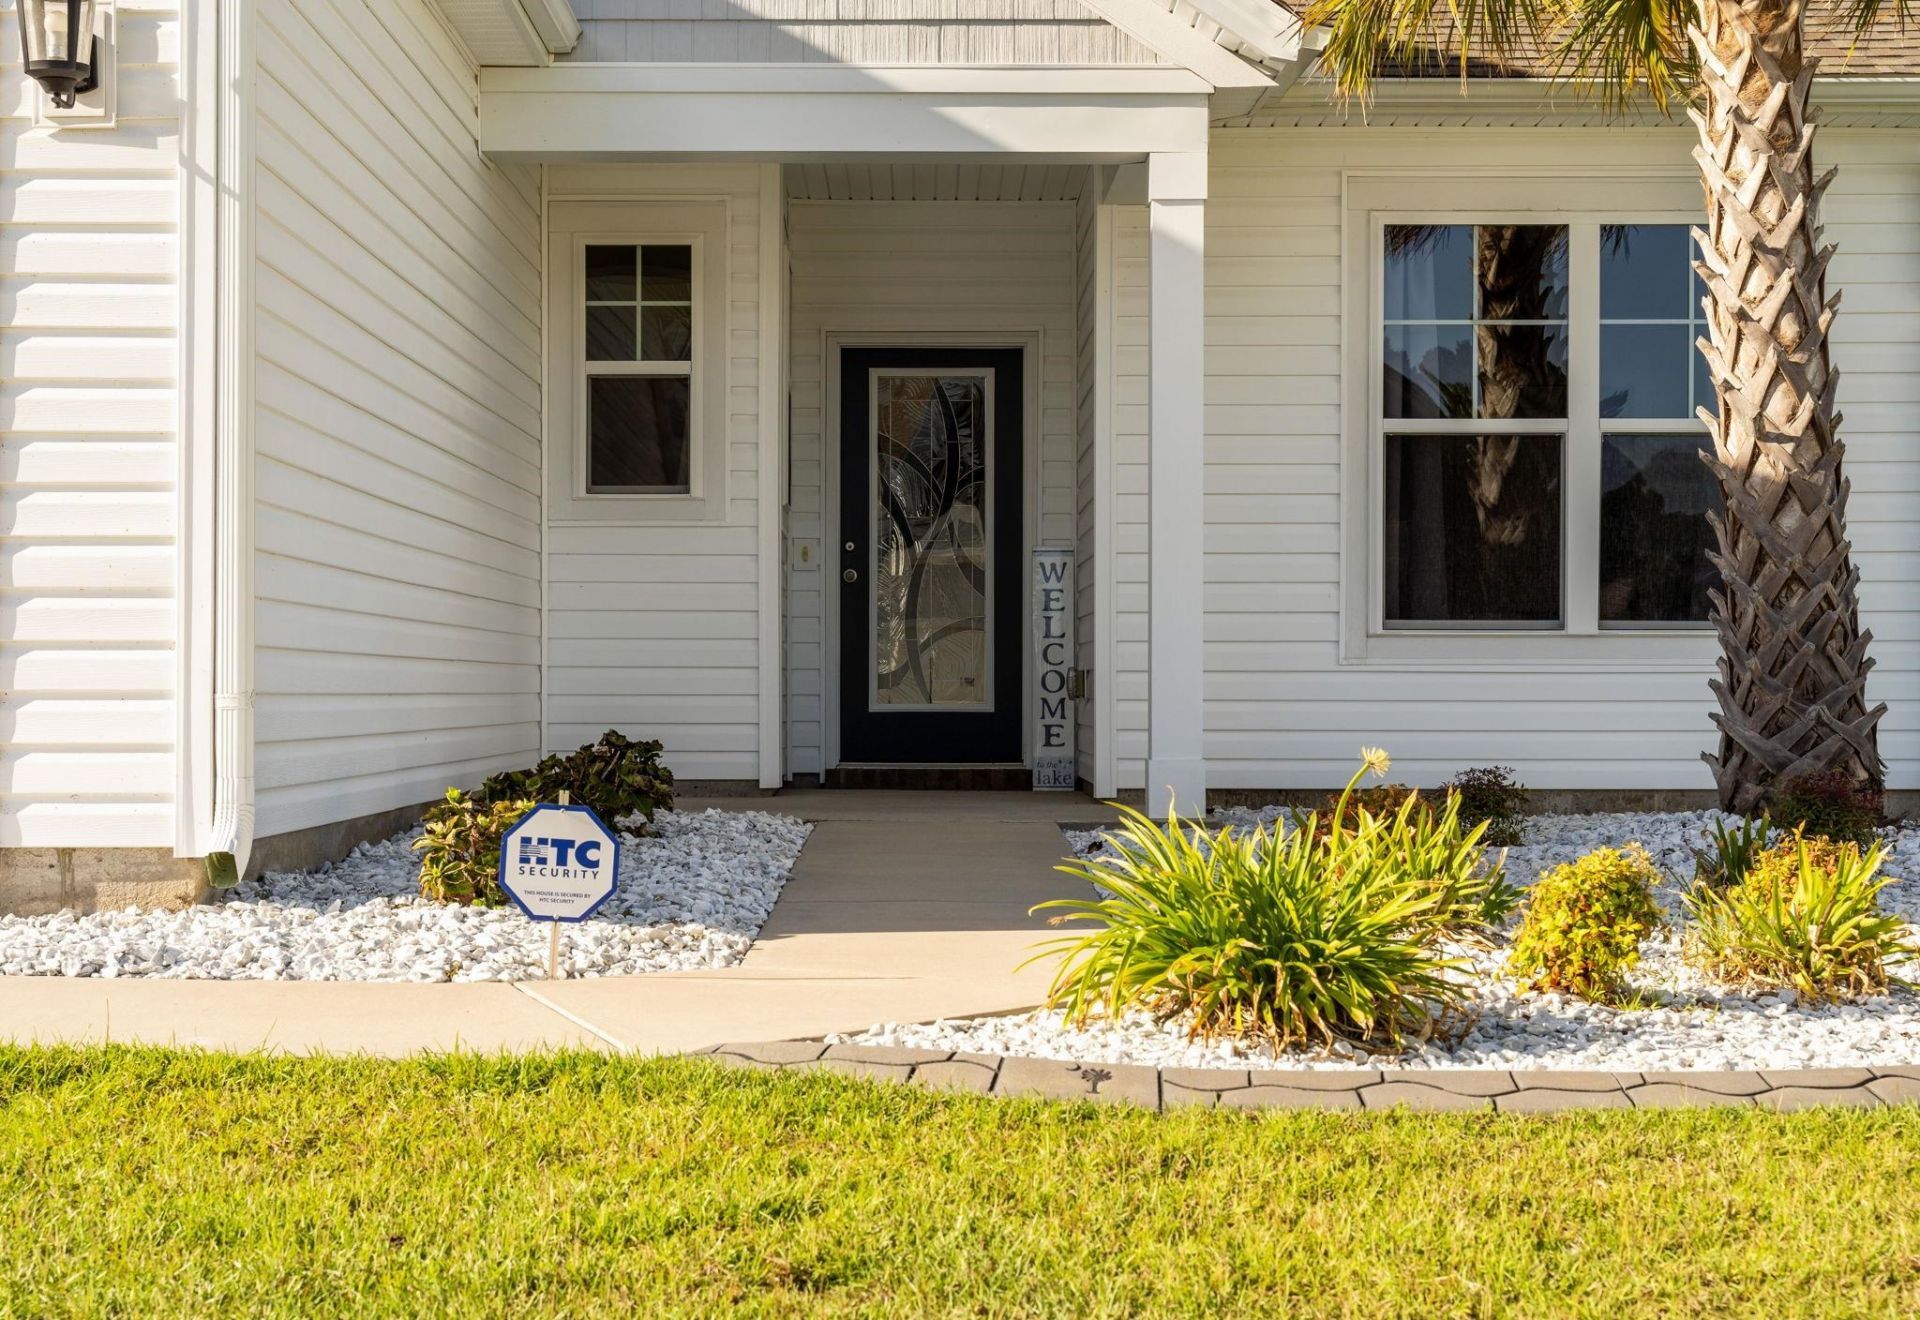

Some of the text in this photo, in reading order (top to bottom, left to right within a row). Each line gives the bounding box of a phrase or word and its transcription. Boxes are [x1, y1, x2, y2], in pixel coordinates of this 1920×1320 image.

[1039, 562, 1067, 747] WELCOME
[1037, 770, 1073, 785] lake
[519, 836, 601, 869] HTC
[518, 866, 600, 880] SECURITY
[550, 897, 575, 905] SECURITY
[560, 891, 584, 899] SECURED
